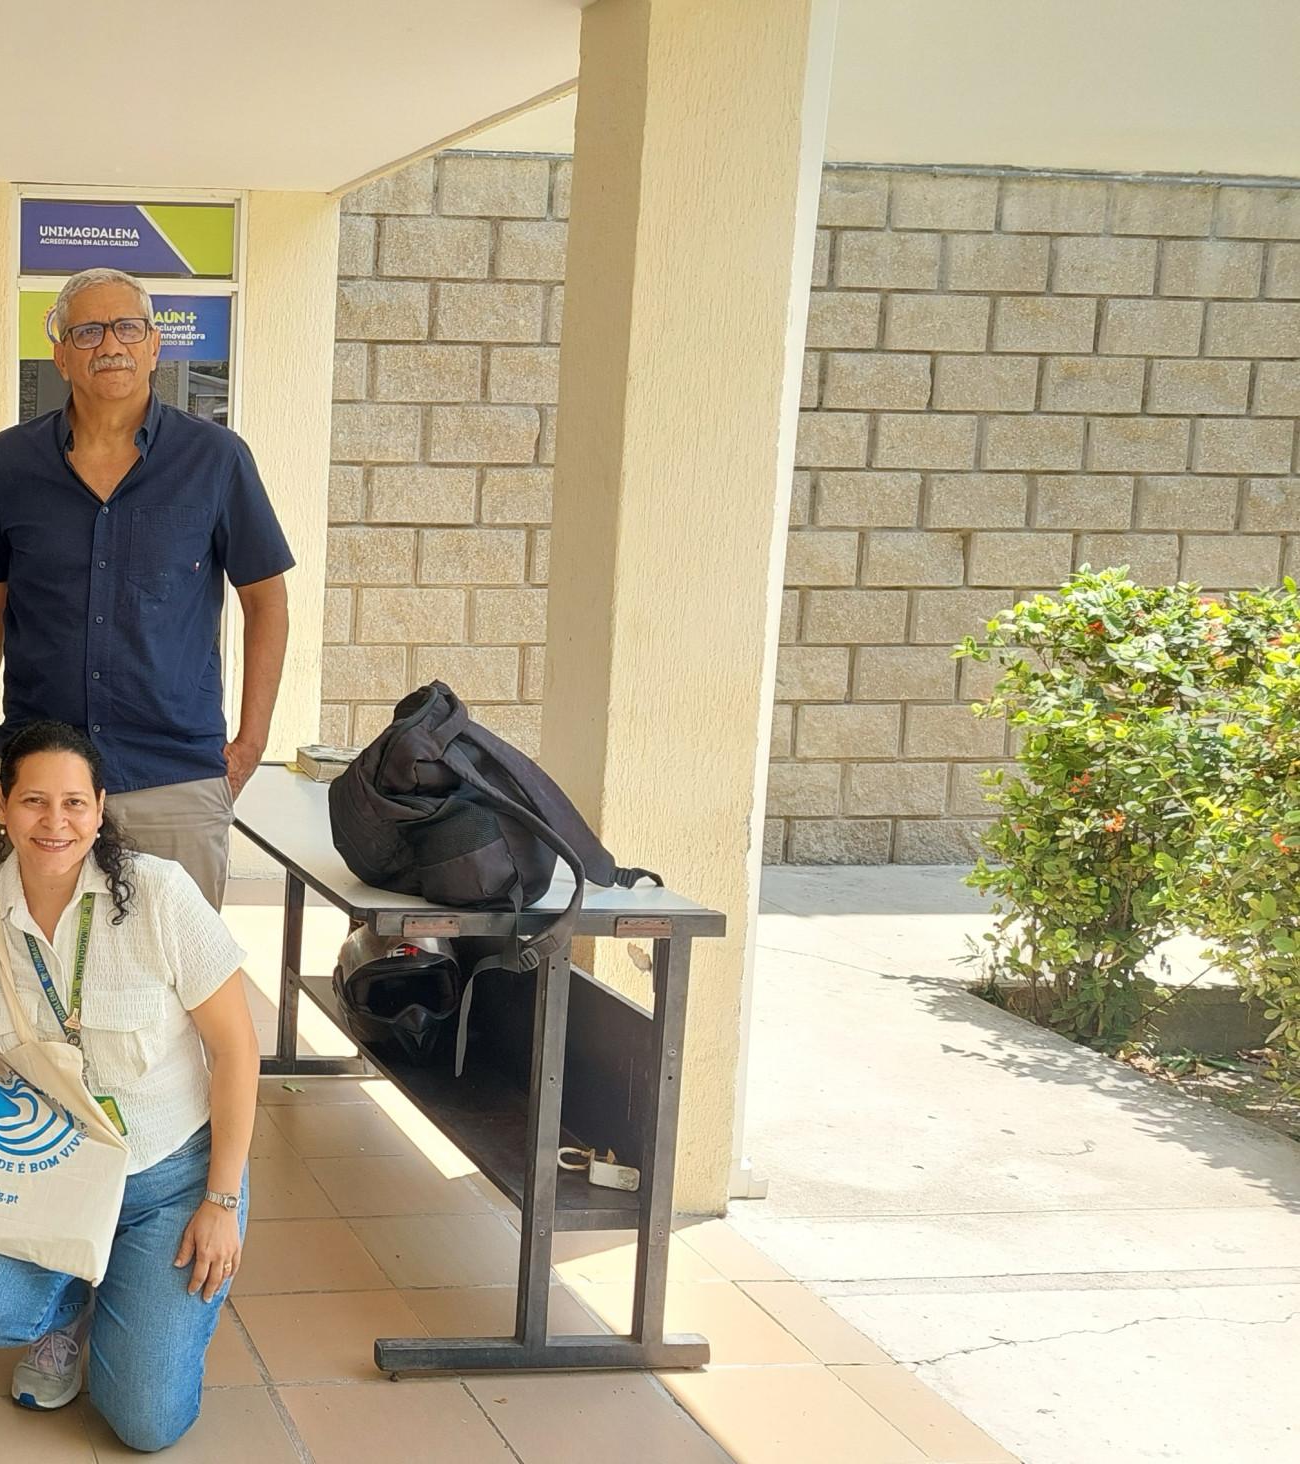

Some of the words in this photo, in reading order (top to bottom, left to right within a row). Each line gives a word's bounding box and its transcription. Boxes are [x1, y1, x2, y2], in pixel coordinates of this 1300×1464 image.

[39, 226, 140, 239] UNIMAGDALENA
[40, 238, 82, 246] ACREDITADA
[75, 917, 92, 981] UNIMAGDALENA
[17, 1161, 26, 1173] É
[29, 1155, 61, 1173] BOM
